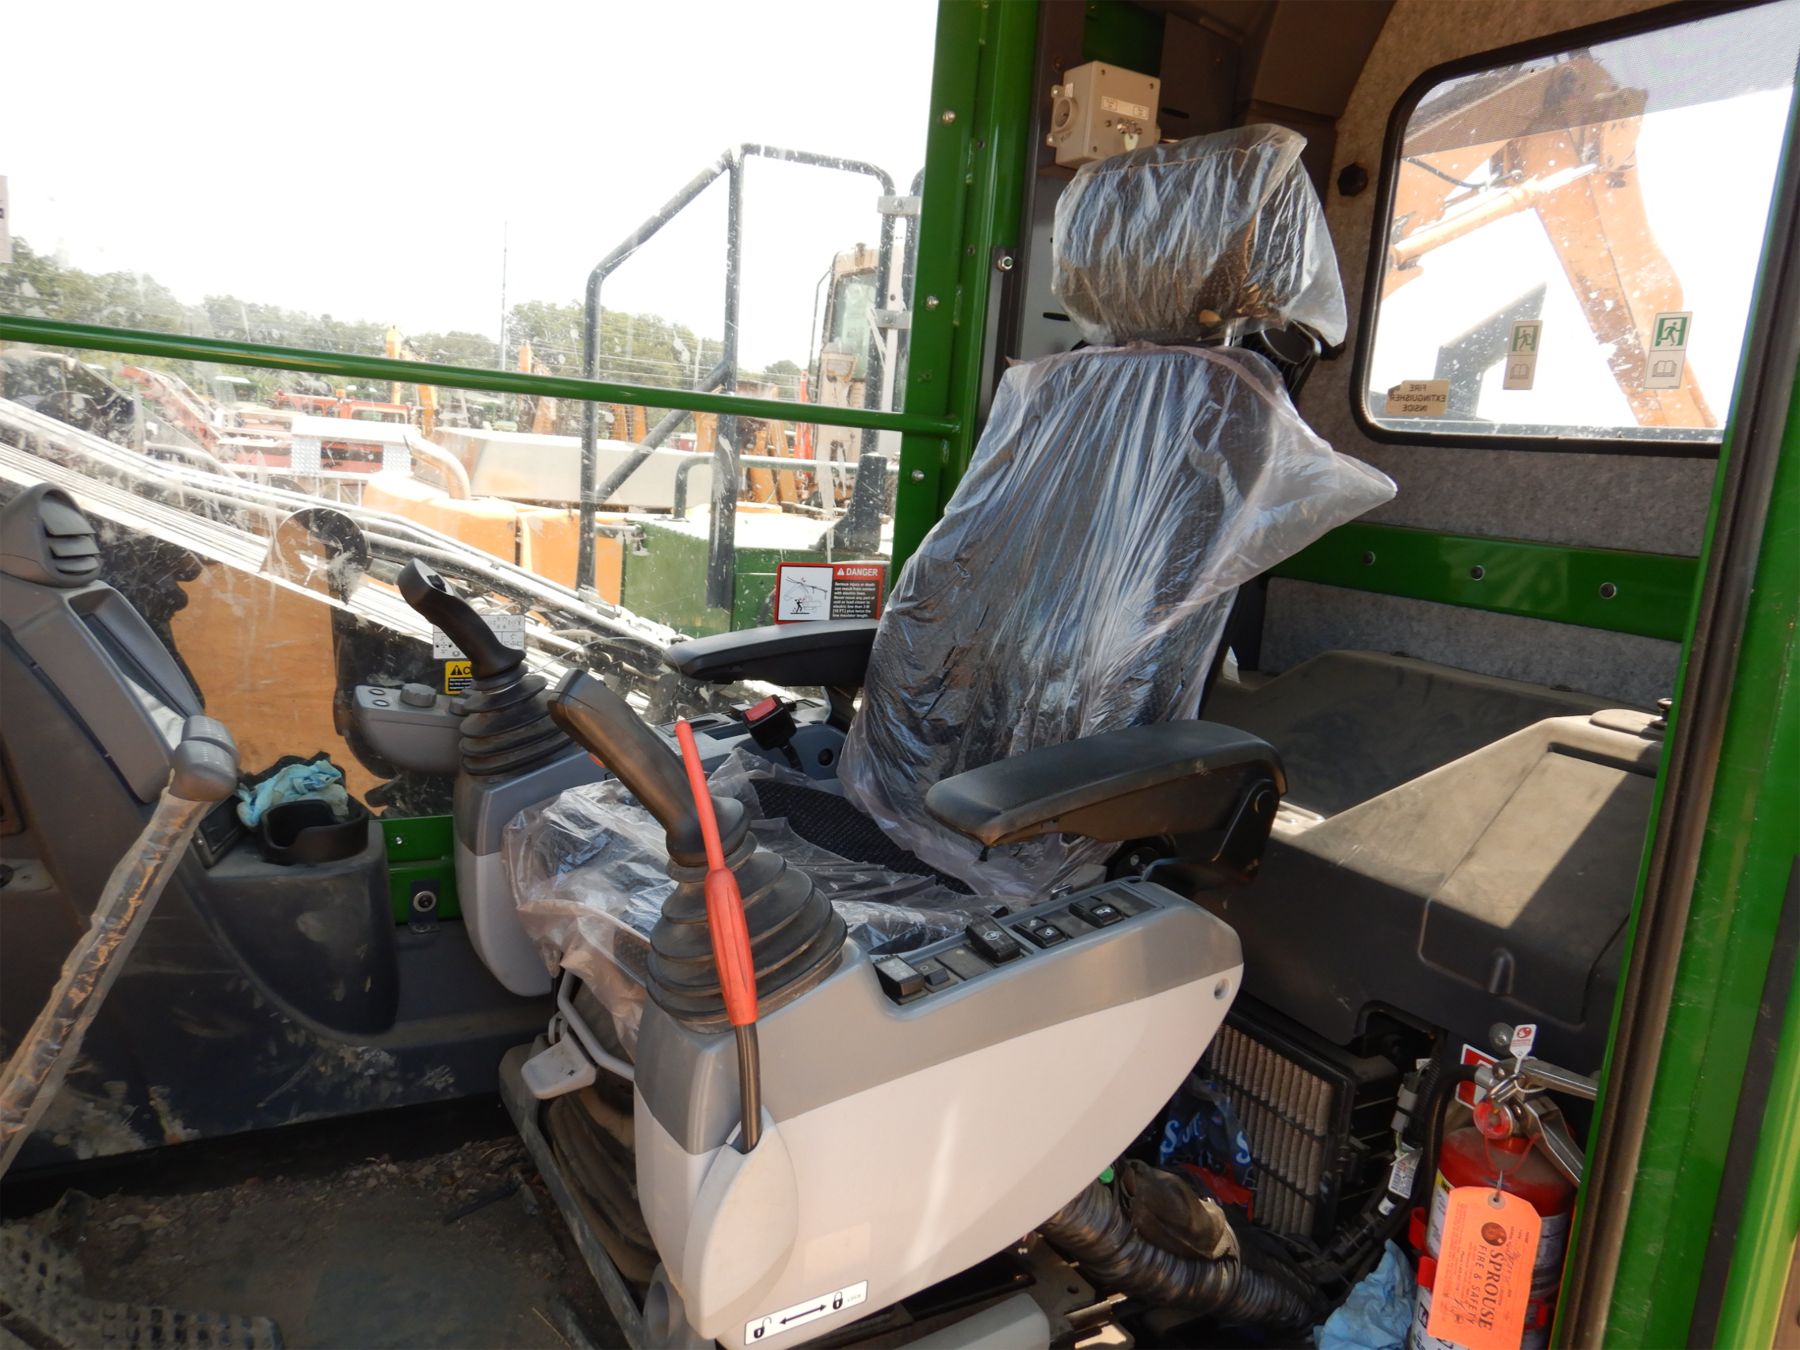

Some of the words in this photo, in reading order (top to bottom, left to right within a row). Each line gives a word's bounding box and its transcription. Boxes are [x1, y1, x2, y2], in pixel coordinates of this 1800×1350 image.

[846, 567, 878, 576] DANGER
[1476, 1244, 1488, 1270] FIRE
[1466, 1286, 1480, 1325] SAFETY
[1478, 1249, 1504, 1331] SPROUSE
